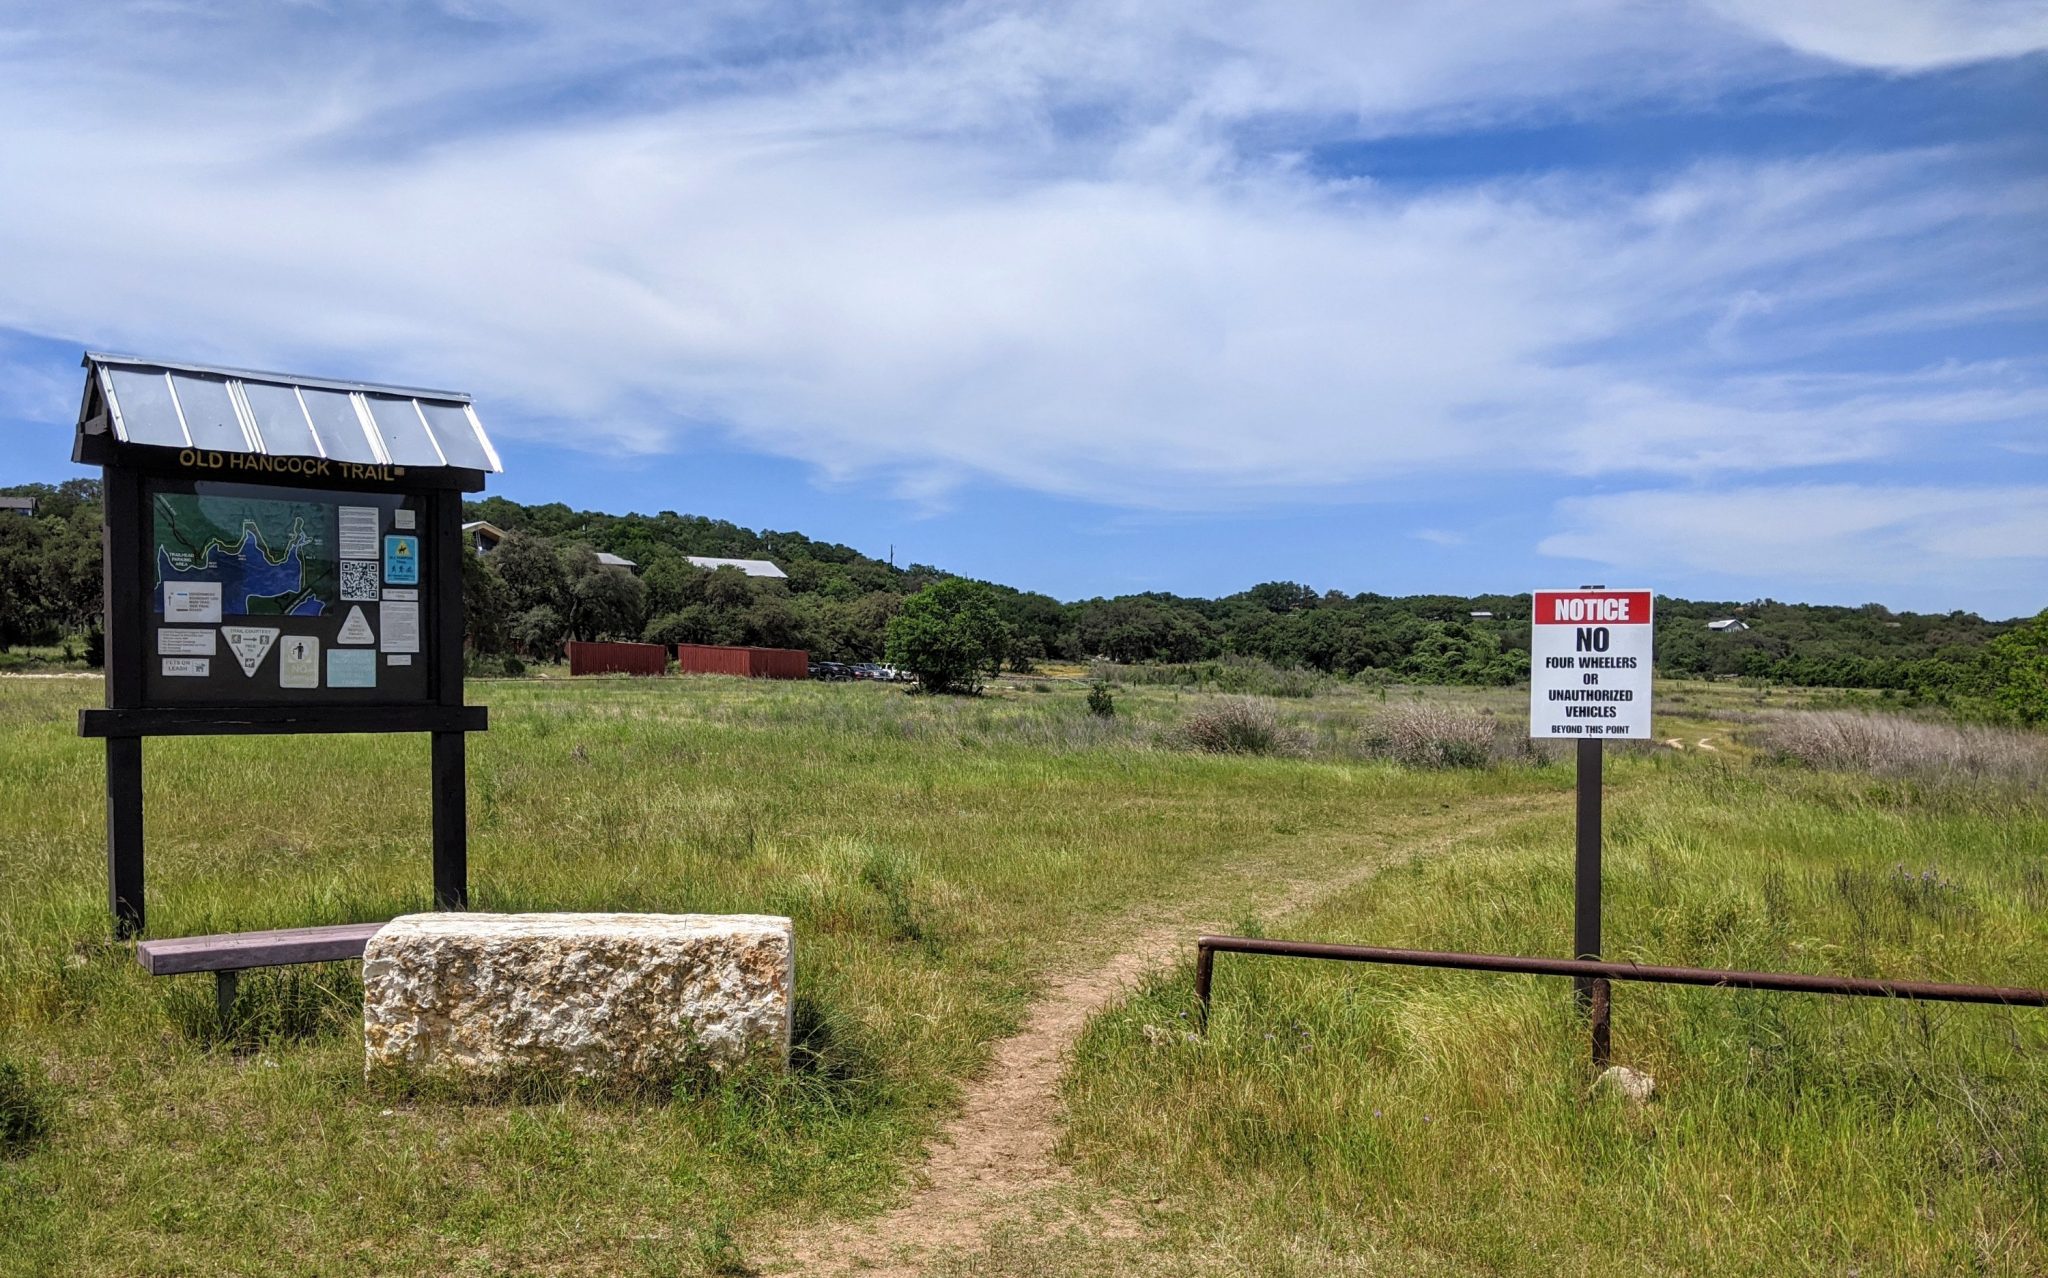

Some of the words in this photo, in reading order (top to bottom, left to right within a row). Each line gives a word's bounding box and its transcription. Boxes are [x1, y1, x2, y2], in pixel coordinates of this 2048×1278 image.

[179, 449, 223, 469] OLD
[229, 453, 331, 477] HANCOCK
[339, 462, 395, 481] TRAIL
[1554, 598, 1630, 621] NOTICE
[1576, 627, 1610, 652] NO
[1545, 656, 1575, 669] FOUR
[1579, 656, 1637, 669] WHEELERS
[1583, 673, 1599, 685] OR
[1548, 689, 1633, 702] UNAUTHORIZED
[1565, 706, 1617, 718] VEHICLES
[1551, 725, 1583, 734] BEYOND
[1585, 725, 1604, 734] THIS
[1606, 725, 1630, 734] POINT
